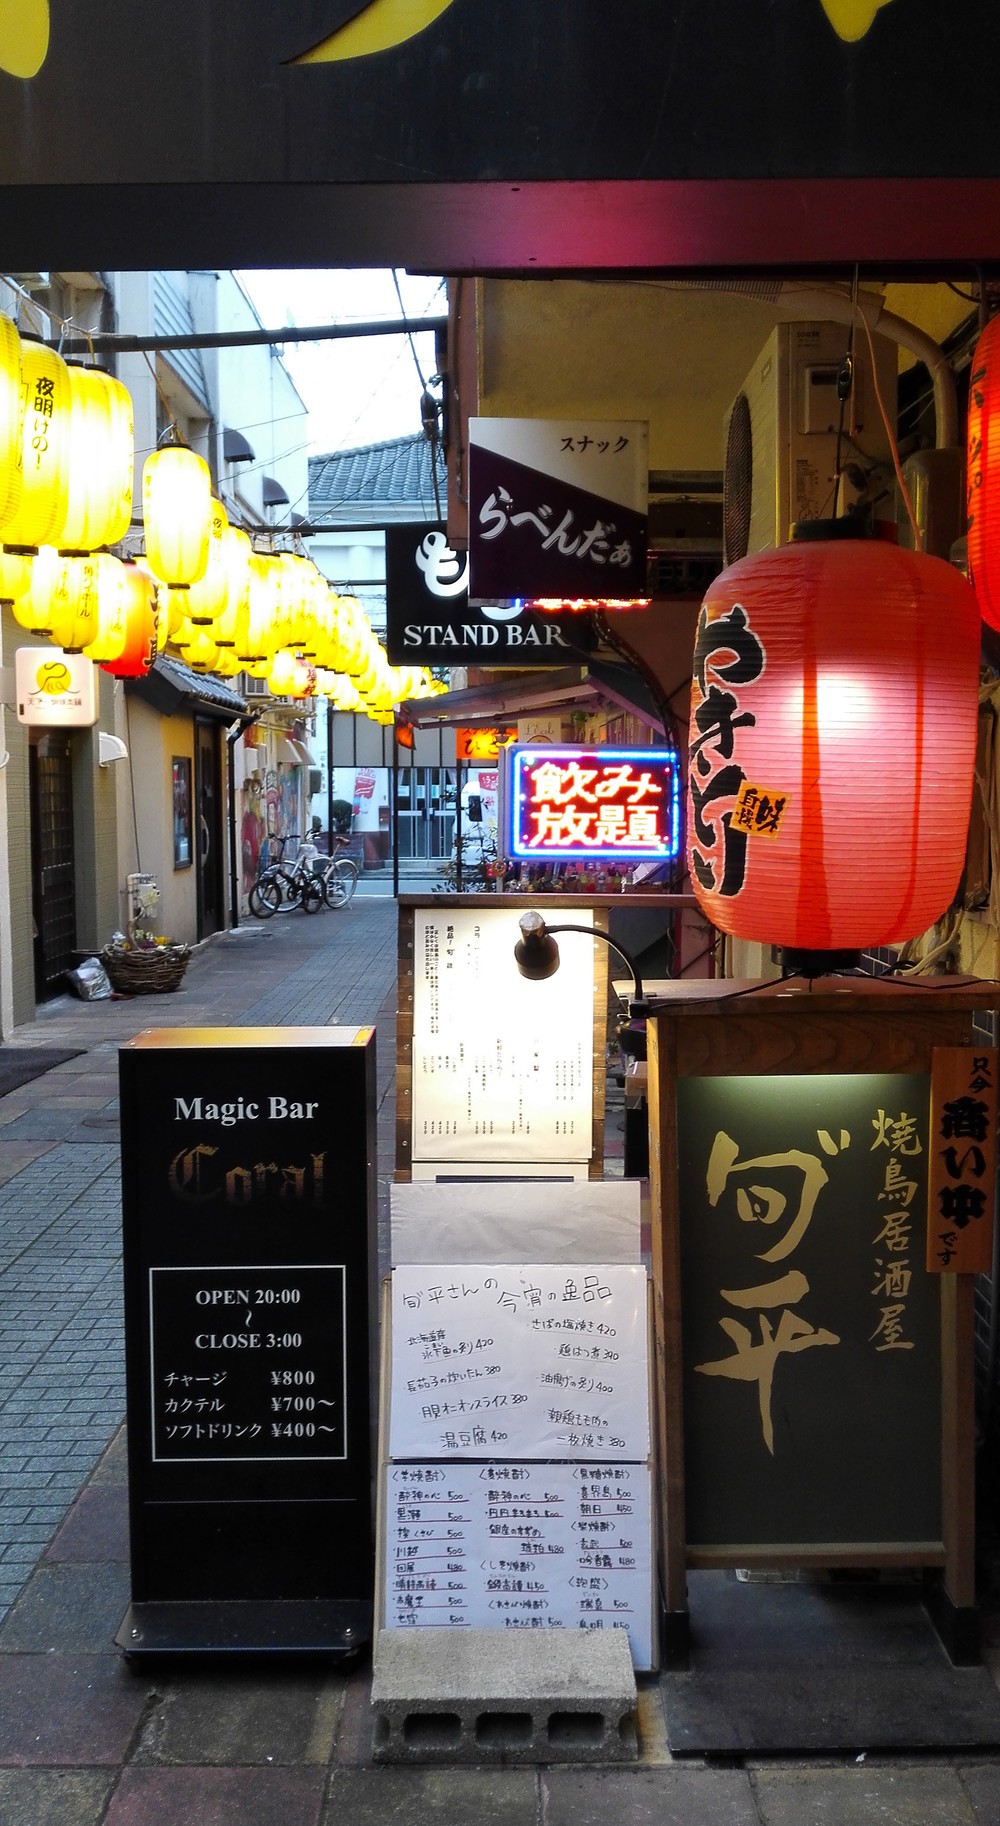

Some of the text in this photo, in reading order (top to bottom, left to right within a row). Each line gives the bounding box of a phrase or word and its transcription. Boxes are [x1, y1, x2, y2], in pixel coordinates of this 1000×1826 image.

[560, 435, 630, 453] スナック
[479, 485, 633, 568] らべんだぁ
[403, 624, 569, 646] STAND BAR
[690, 602, 767, 897] やきとり
[530, 761, 662, 804] 飲み
[529, 804, 661, 848] 放題
[174, 1096, 319, 1126] Magic Bar
[869, 1109, 923, 1352] 焼鳥居酒屋
[195, 1289, 300, 1305] OPEN 20:00
[596, 1323, 616, 1337] 420
[195, 1333, 302, 1349] CLOSE 3:00
[475, 1338, 494, 1350] 420
[163, 1371, 315, 1387] チャージ ¥800
[595, 1381, 613, 1393] 400
[164, 1398, 225, 1413] カクテル
[165, 1423, 263, 1439] ソフトドリンク
[440, 1425, 508, 1449] 湯豆腐 420
[447, 1490, 463, 1501] 500
[544, 1492, 559, 1502] 500
[616, 1487, 632, 1499] 500
[544, 1509, 560, 1518] 500
[616, 1503, 632, 1513] 450
[447, 1512, 463, 1522] 500
[447, 1529, 463, 1538] 500
[619, 1538, 633, 1549] 500
[447, 1546, 463, 1555] 500
[618, 1557, 636, 1566] 480
[448, 1581, 464, 1590] 500
[526, 1581, 545, 1591] 450
[448, 1596, 463, 1606] 500
[613, 1599, 629, 1609] 500
[449, 1614, 464, 1624] 500
[547, 1616, 563, 1626] 500
